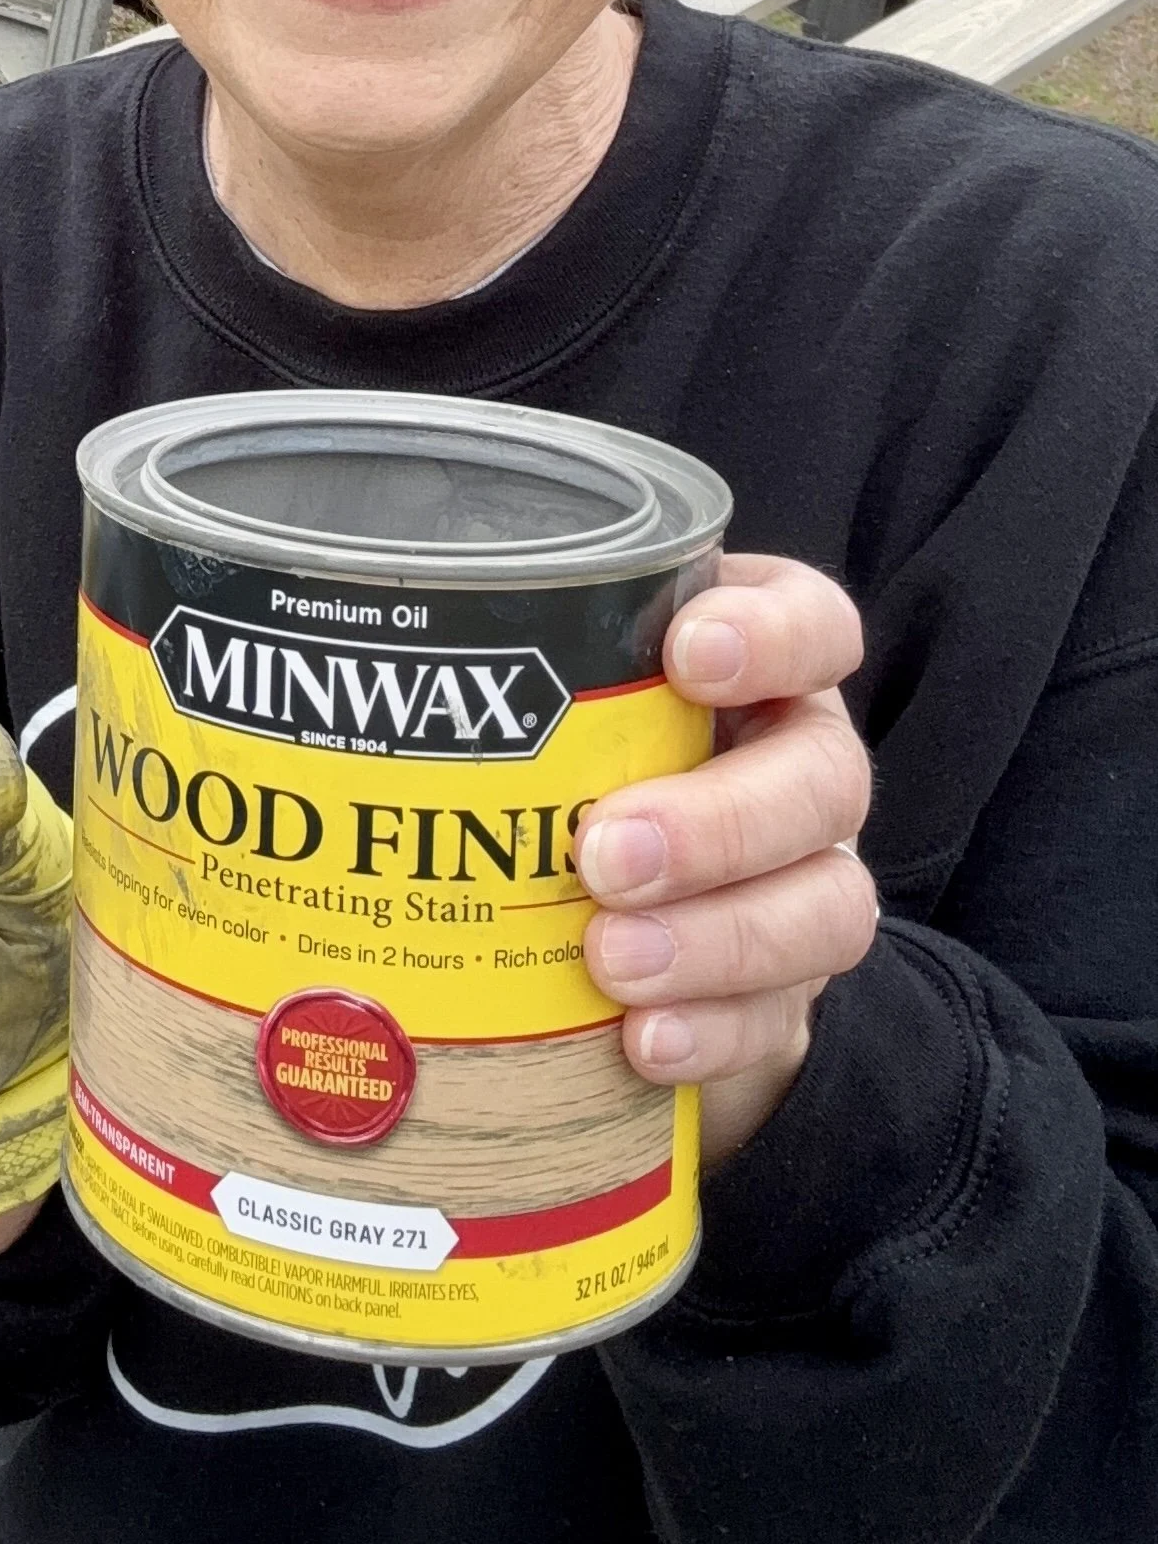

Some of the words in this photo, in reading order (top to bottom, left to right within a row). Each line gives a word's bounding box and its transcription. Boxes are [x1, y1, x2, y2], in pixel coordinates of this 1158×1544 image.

[270, 589, 382, 626] Premium
[391, 605, 428, 629] Oil
[300, 730, 346, 751] SINCE
[349, 736, 388, 755] 1904
[90, 707, 324, 862] WOOD
[200, 851, 393, 929] Penetrating
[405, 891, 495, 923] Stain
[153, 885, 174, 911] for
[178, 902, 218, 930] even
[222, 918, 270, 944] color
[298, 933, 352, 963] Dries
[358, 943, 376, 964] in
[382, 946, 397, 967] 2
[403, 946, 465, 970] hours
[494, 946, 538, 969] Rich
[281, 1026, 389, 1062] PROFESSIONAL
[304, 1050, 367, 1077] RESULTS
[275, 1062, 393, 1102] GUARANTEED
[74, 1079, 176, 1185] SEMI-TRANSPARENT
[118, 1185, 138, 1215] FATAL
[139, 1201, 146, 1217] IF
[207, 1237, 282, 1277] COMBUSTIBLE!
[284, 1261, 323, 1287] VAPOR
[389, 1281, 446, 1301] IRRITATES
[448, 1283, 480, 1303] EYES,
[238, 1197, 323, 1235] CLASSIC
[329, 1219, 386, 1246] GRAY
[392, 1228, 428, 1250] 271
[131, 1216, 158, 1245] Before
[187, 1251, 228, 1282] carefully
[231, 1270, 255, 1288] read
[257, 1275, 314, 1305] CAUTIONS
[315, 1293, 332, 1307] on
[334, 1293, 362, 1314] back
[365, 1302, 402, 1319] panel.
[575, 1277, 592, 1302] 32
[594, 1271, 607, 1295] FL
[610, 1262, 627, 1288] OZ
[628, 1255, 636, 1283] /
[637, 1245, 656, 1276] 946
